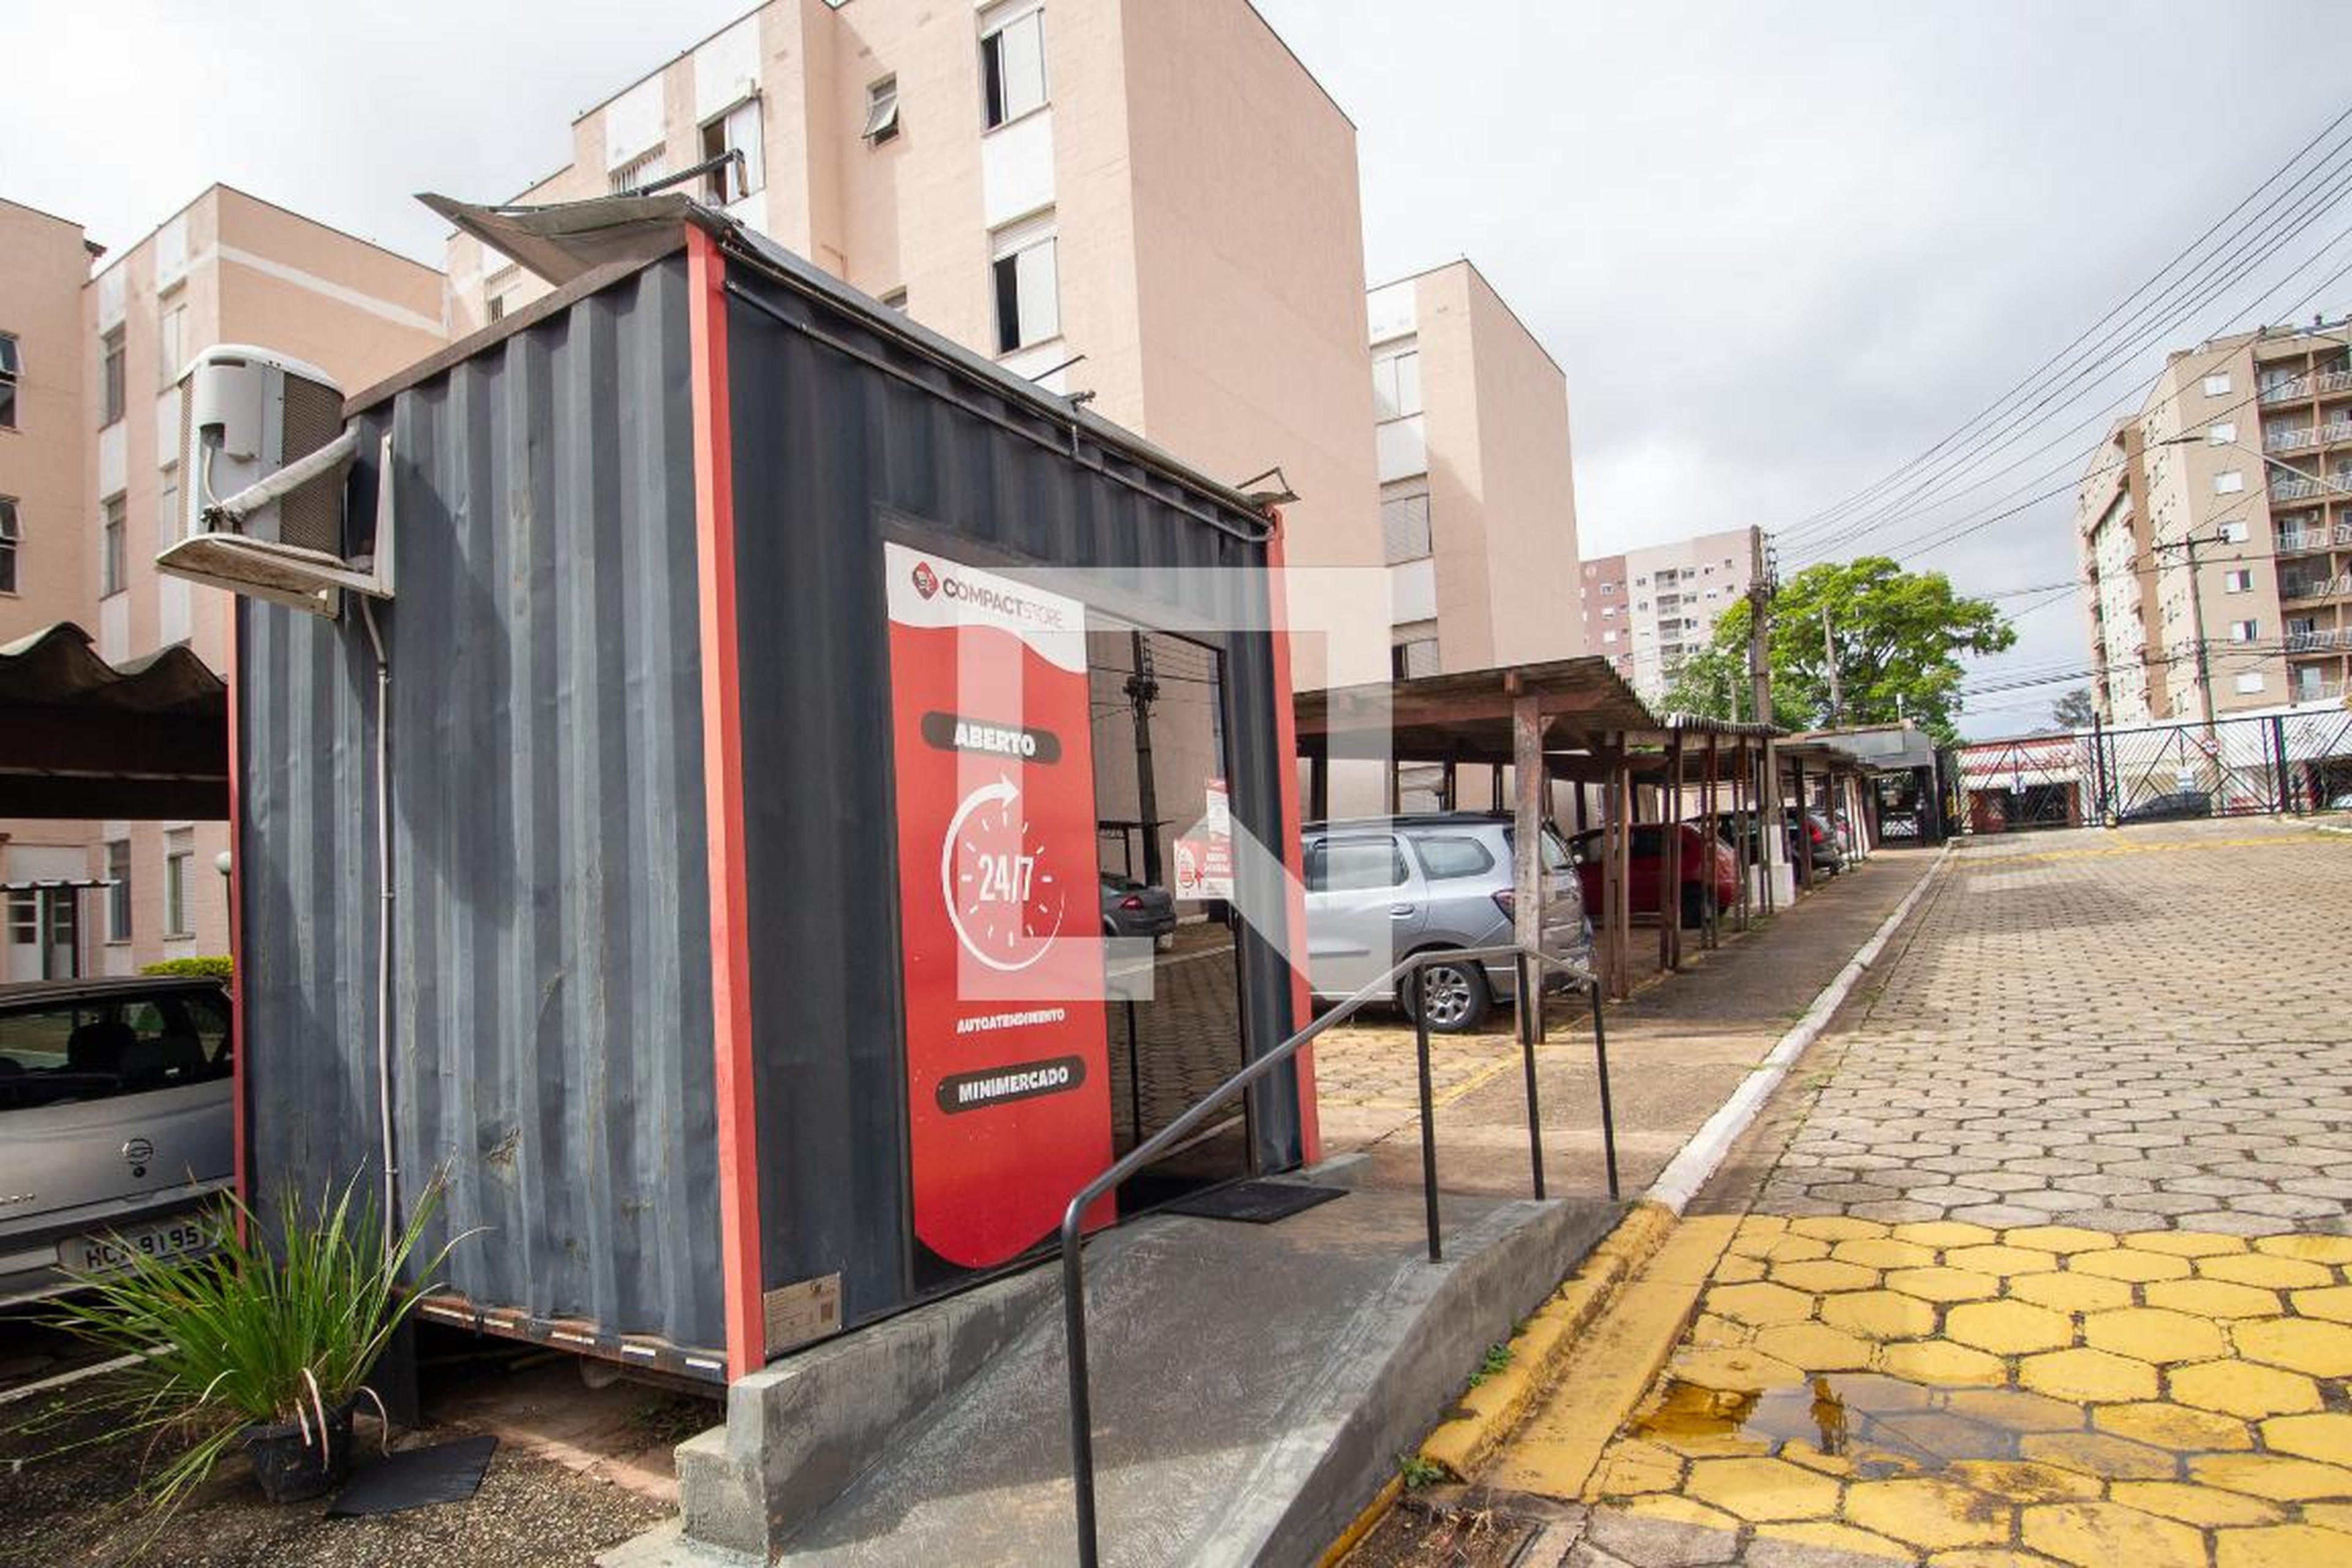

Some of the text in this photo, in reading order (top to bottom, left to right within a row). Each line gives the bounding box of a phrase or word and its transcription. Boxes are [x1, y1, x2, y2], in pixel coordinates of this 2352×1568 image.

[954, 722, 1035, 756] ABERTO
[979, 854, 1033, 903] 24/7
[957, 1009, 1065, 1033] AUTOATENDIMENTO
[959, 1067, 1068, 1102] MINIMERCADO
